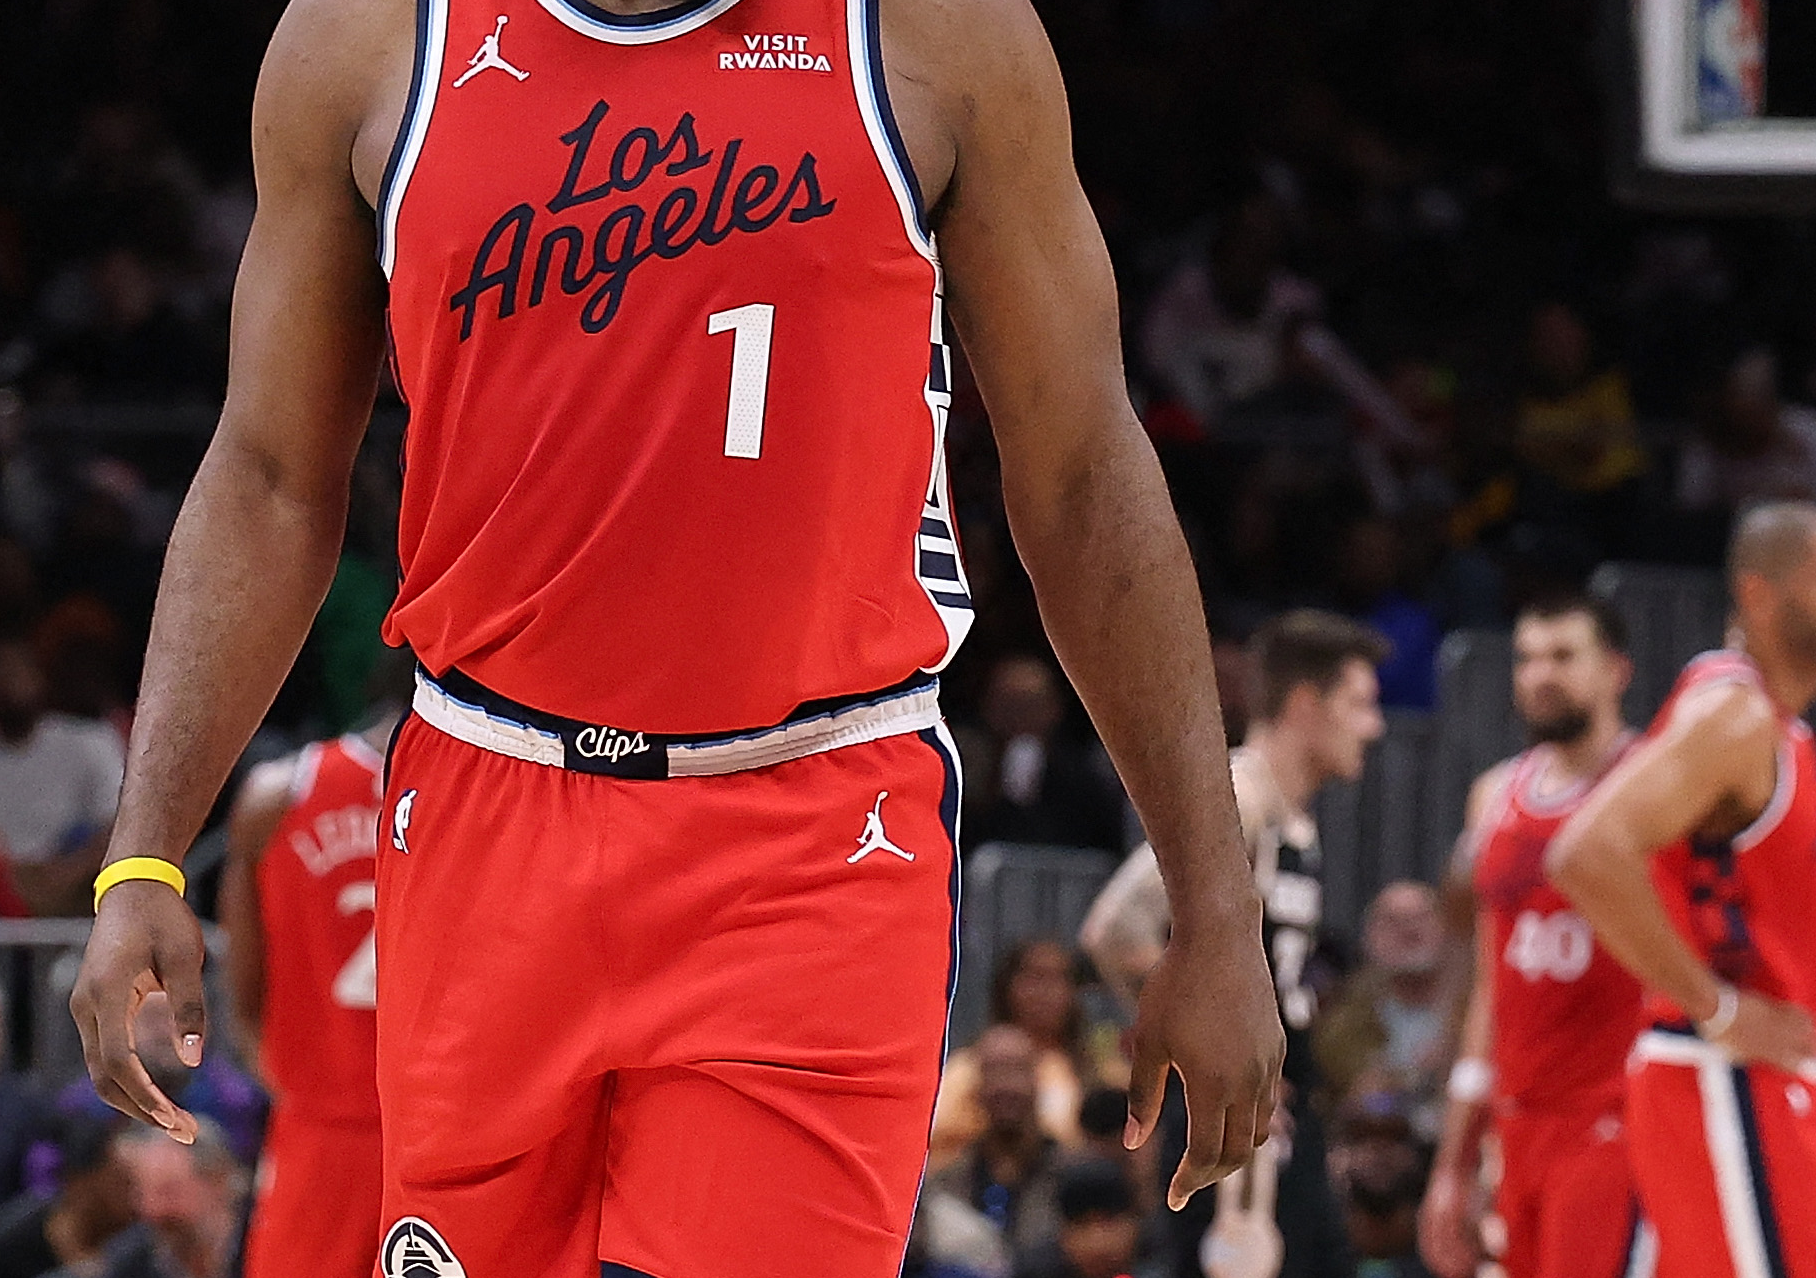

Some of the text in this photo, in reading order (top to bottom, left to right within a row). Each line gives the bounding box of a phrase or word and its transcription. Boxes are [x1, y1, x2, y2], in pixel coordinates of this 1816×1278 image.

[719, 52, 832, 72] RWANDA
[743, 34, 808, 52] VISIT
[545, 99, 713, 213] Los
[449, 139, 838, 344] Angeles
[708, 302, 775, 460] 1
[575, 726, 650, 763] Clips
